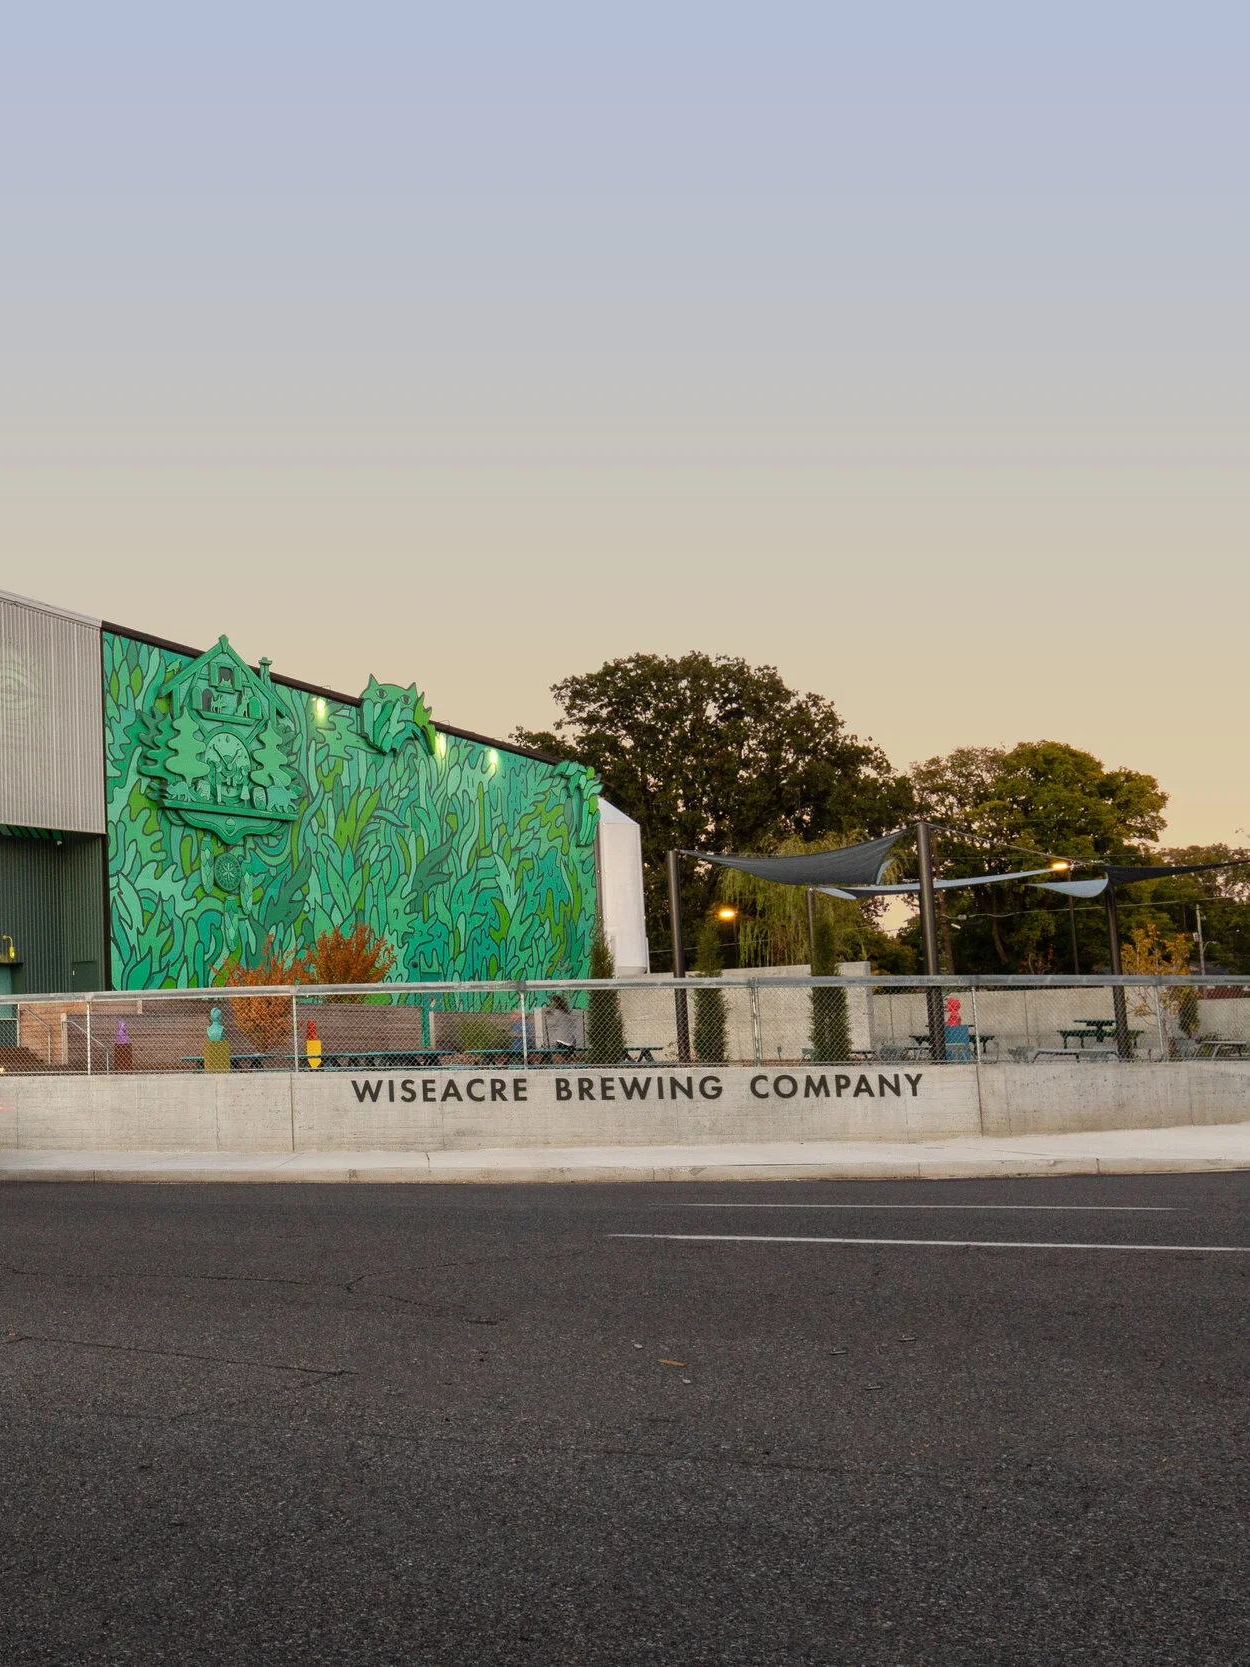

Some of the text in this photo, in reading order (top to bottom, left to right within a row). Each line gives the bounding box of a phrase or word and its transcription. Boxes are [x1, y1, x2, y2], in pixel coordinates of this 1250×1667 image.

[350, 1073, 924, 1103] WISEACRE BREWING COMPANY
